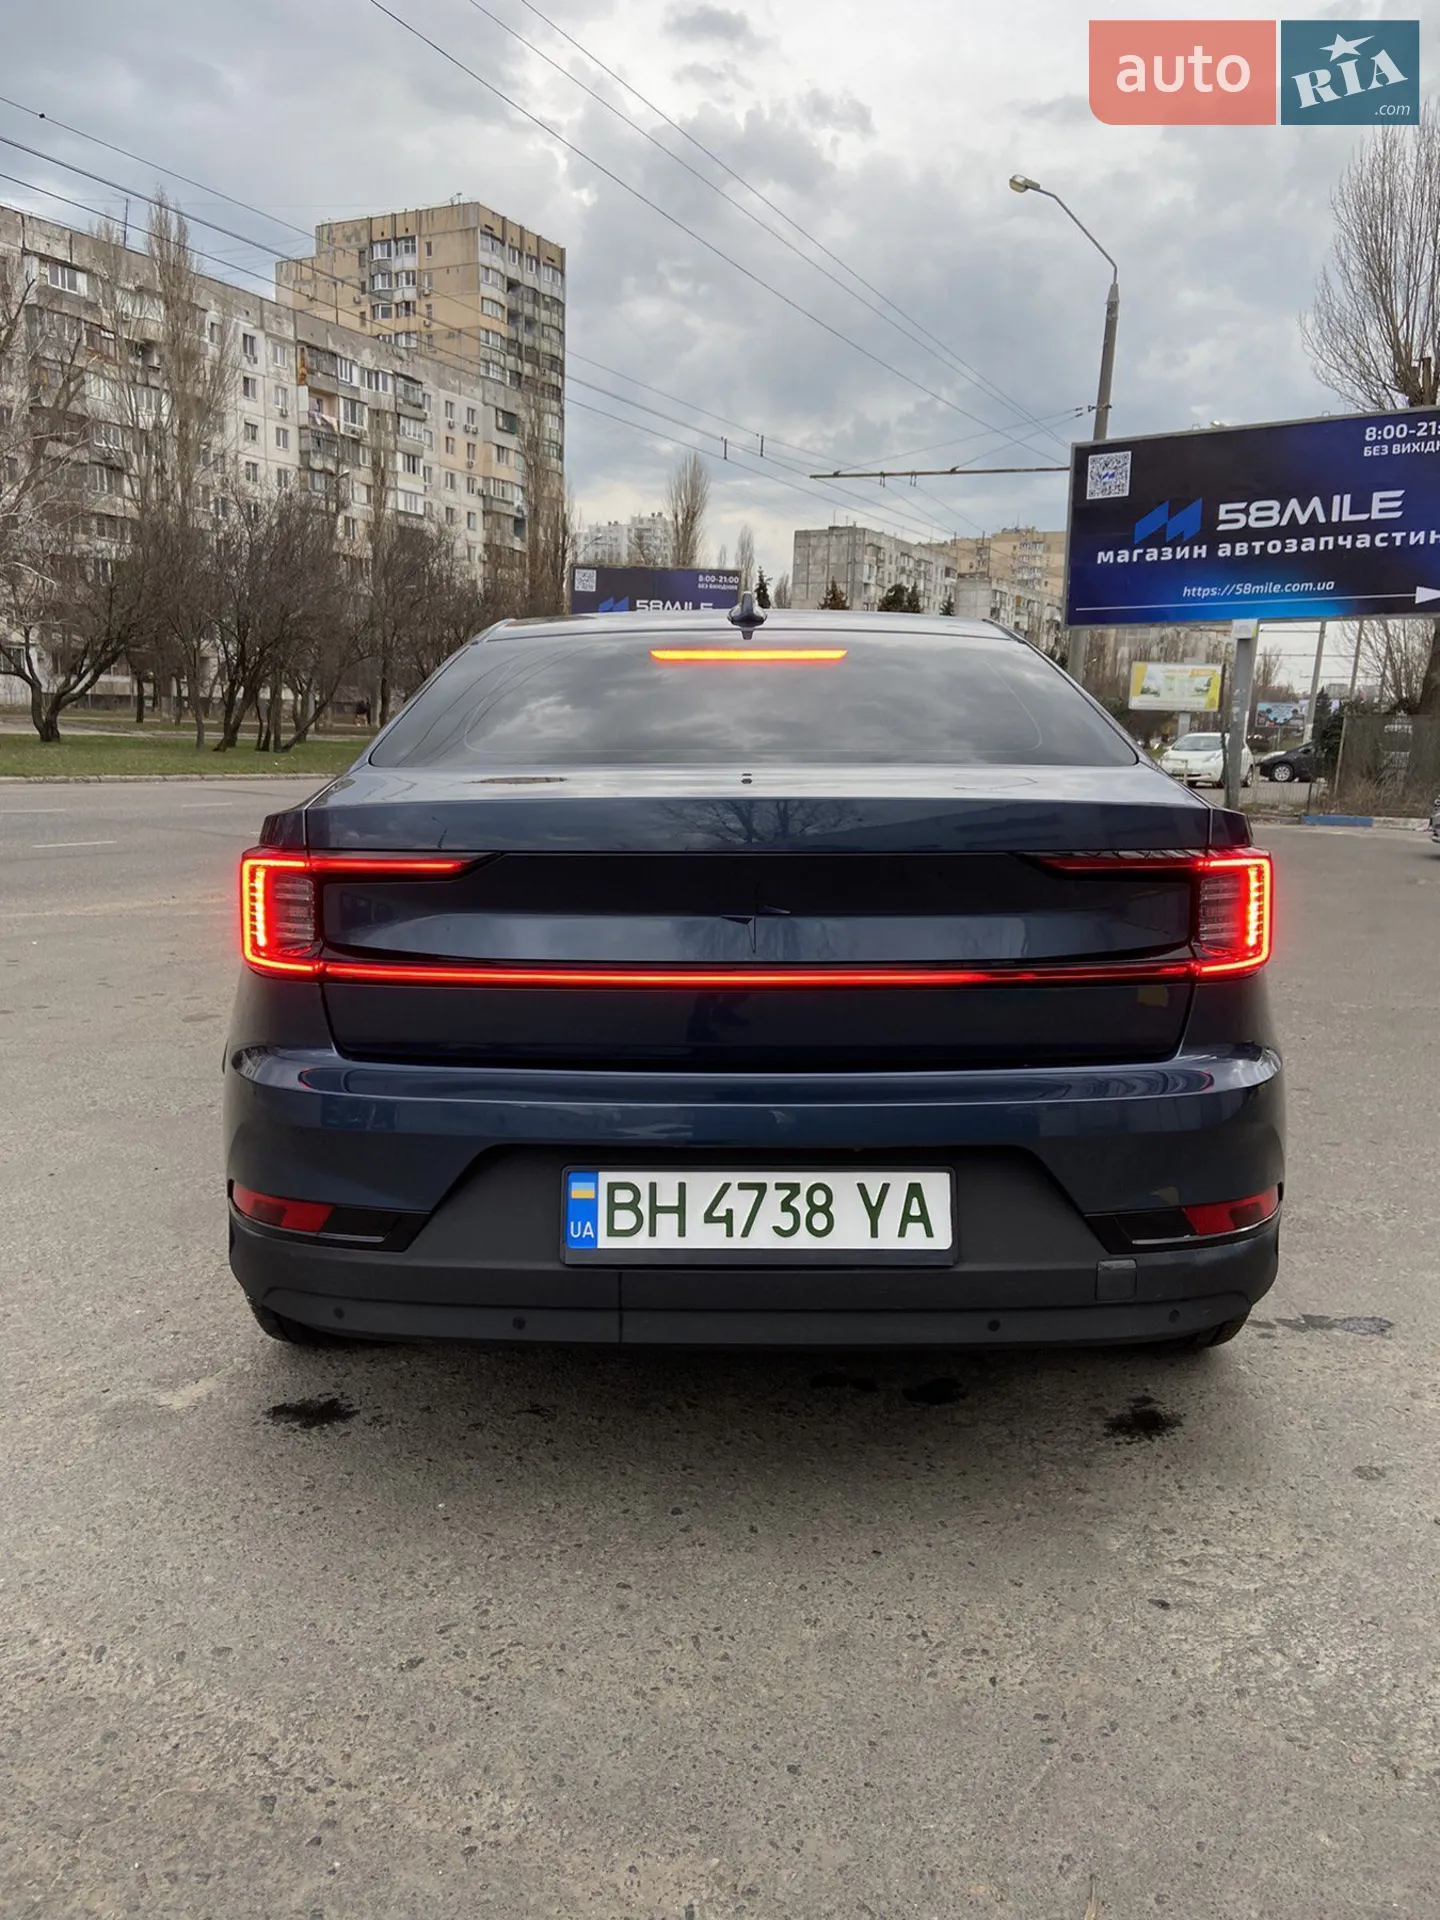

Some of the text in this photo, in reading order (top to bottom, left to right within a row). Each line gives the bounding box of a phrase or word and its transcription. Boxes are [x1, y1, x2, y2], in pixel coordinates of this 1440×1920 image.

[1363, 444, 1389, 457] БЕЗ
[1216, 490, 1405, 531] 58MILE
[1096, 544, 1207, 564] магазин
[1182, 580, 1335, 598] https://58mile.com.ua
[606, 1181, 934, 1238] BH 4738 YA
[570, 1221, 594, 1239] UA
